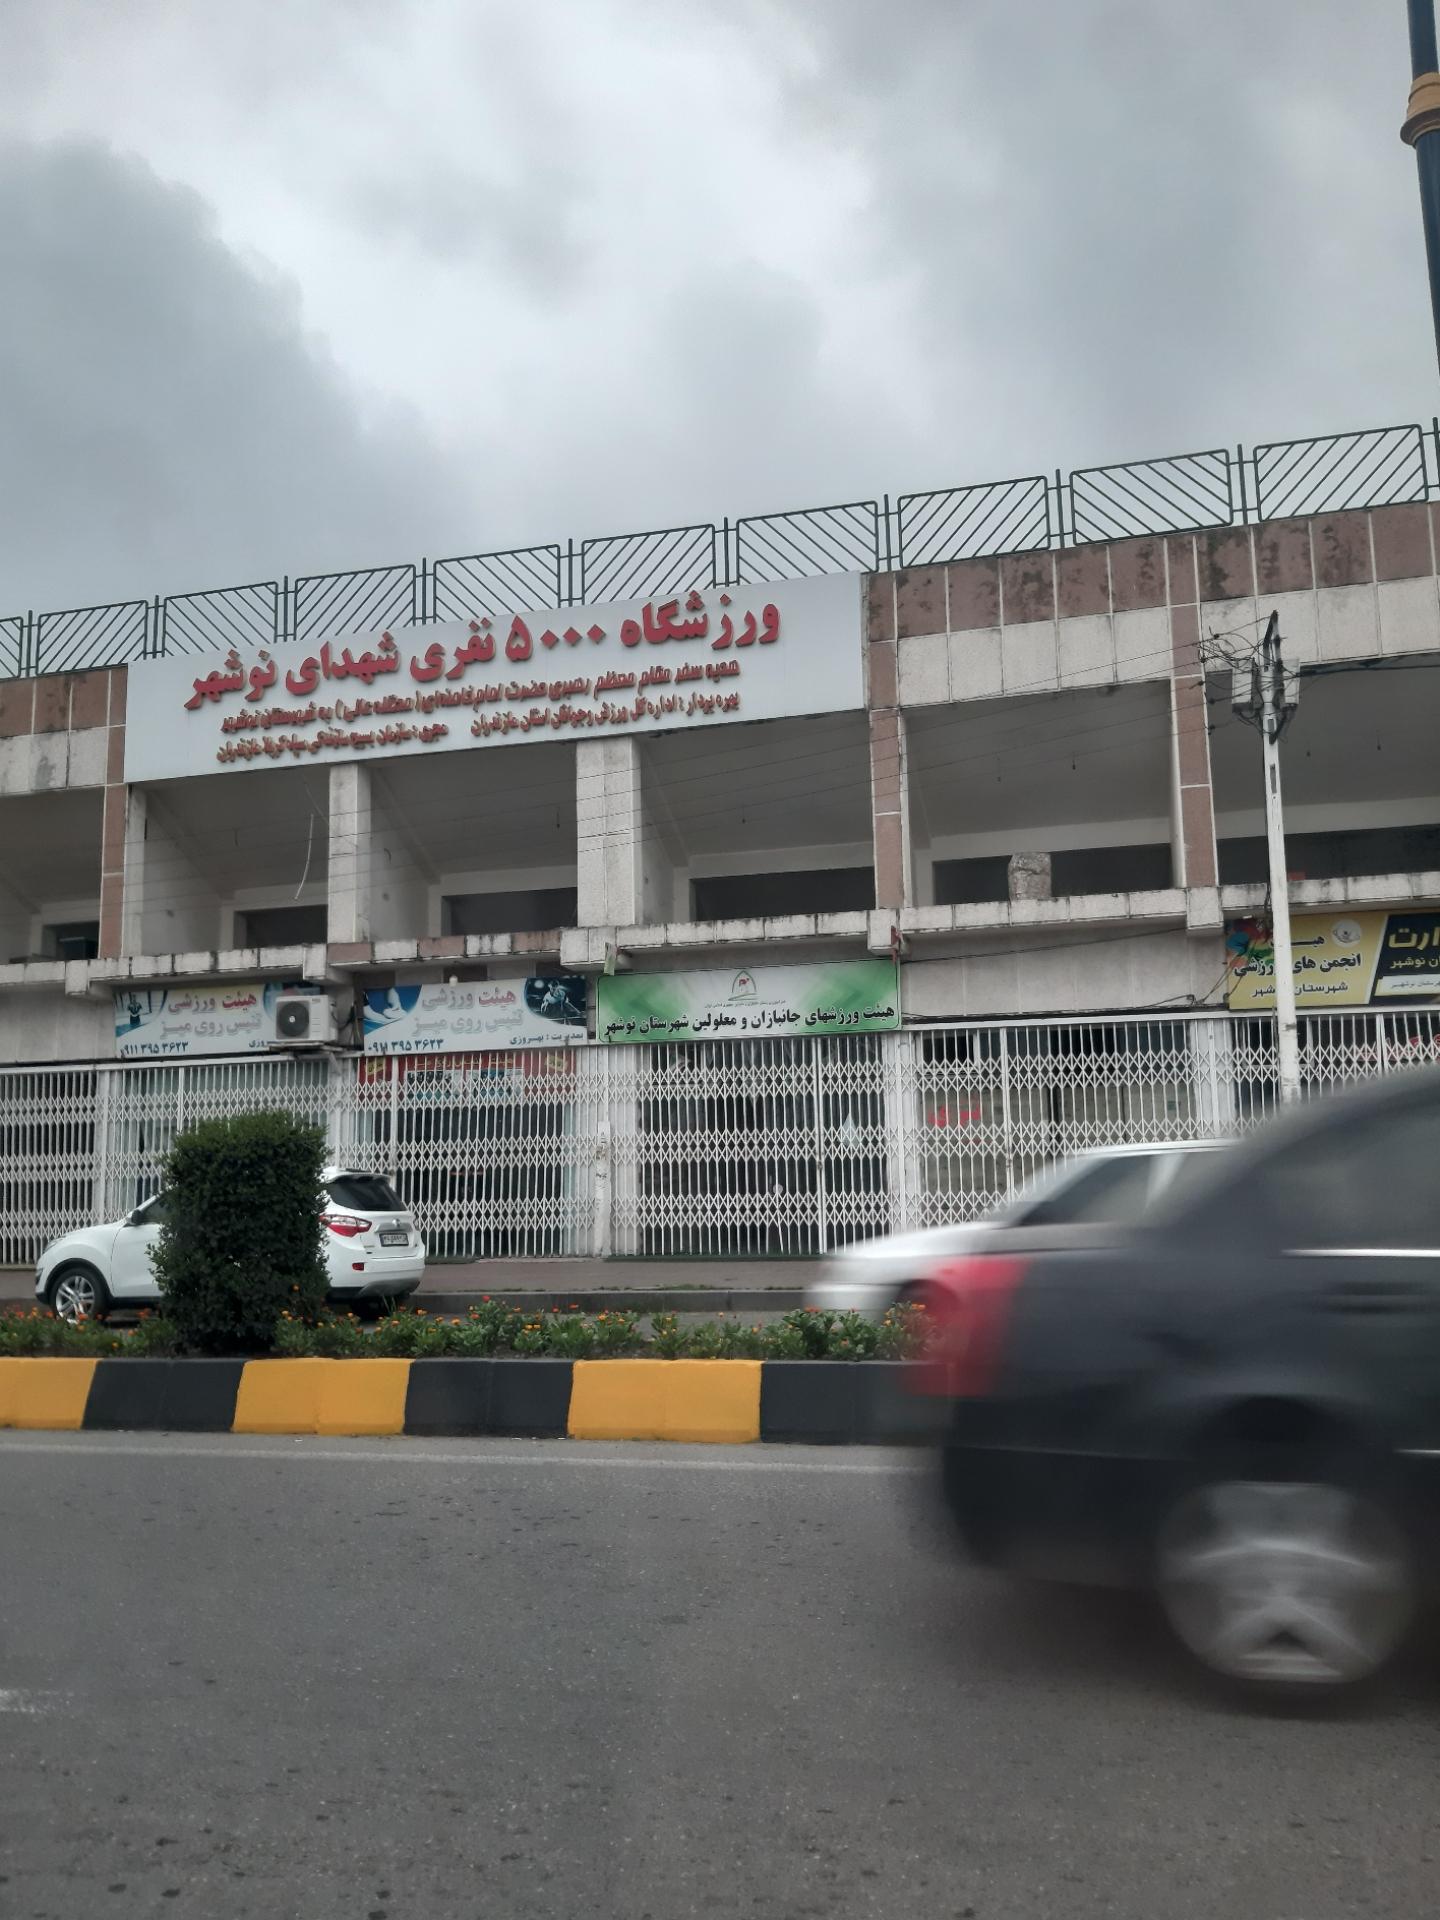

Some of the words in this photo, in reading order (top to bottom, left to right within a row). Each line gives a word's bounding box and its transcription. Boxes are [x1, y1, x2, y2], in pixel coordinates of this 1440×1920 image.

[620, 590, 780, 651] ورزشگاه
[505, 615, 606, 662] ۵۰۰۰
[410, 617, 496, 682] نفری
[286, 631, 400, 696] شهدای
[184, 649, 278, 710] نوشهر
[1234, 957, 1275, 977] رزشی
[1292, 955, 1316, 974] های
[1320, 953, 1361, 973] انجمن
[1389, 957, 1426, 969] نوشهر
[421, 986, 474, 1011] ورزشی
[479, 987, 516, 1008] هیئت
[1252, 984, 1276, 997] شهر
[1294, 982, 1348, 996] شهرستان
[168, 994, 216, 1015] ورزشی
[222, 991, 257, 1011] هیئت
[692, 1013, 737, 1031] معلولین
[751, 1008, 801, 1029] جانبازان
[805, 1007, 859, 1026] ورزشهای
[863, 1004, 895, 1020] هیئت
[160, 1021, 192, 1040] میز
[195, 1021, 223, 1037] روی
[413, 1017, 447, 1037] میز
[452, 1017, 481, 1034] روی
[604, 1017, 636, 1036] نوشهر
[639, 1014, 689, 1034] شهرستان
[741, 1017, 748, 1030] و
